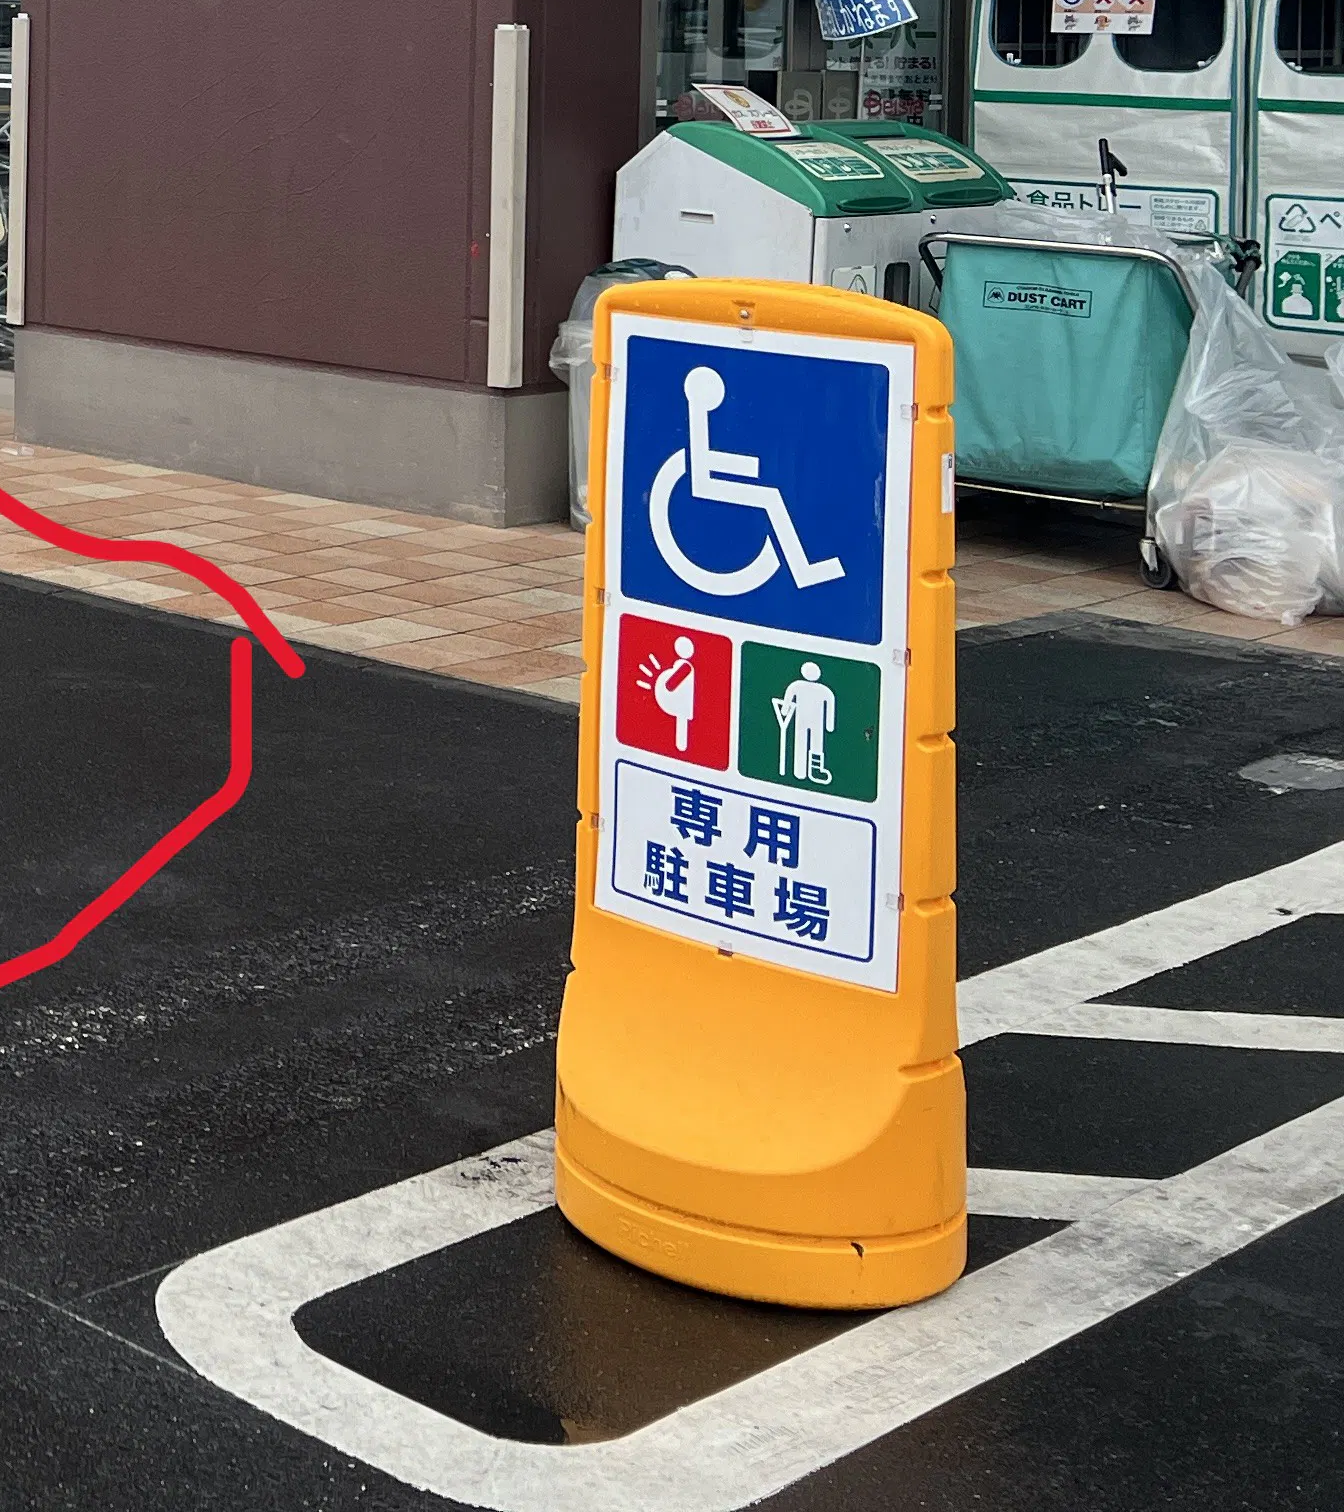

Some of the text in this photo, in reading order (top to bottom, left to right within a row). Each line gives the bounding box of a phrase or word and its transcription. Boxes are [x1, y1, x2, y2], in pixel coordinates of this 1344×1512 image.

[1007, 291, 1047, 304] DUST
[1050, 296, 1087, 310] CART
[670, 785, 801, 869] 専用
[643, 840, 830, 942] 駐車場
